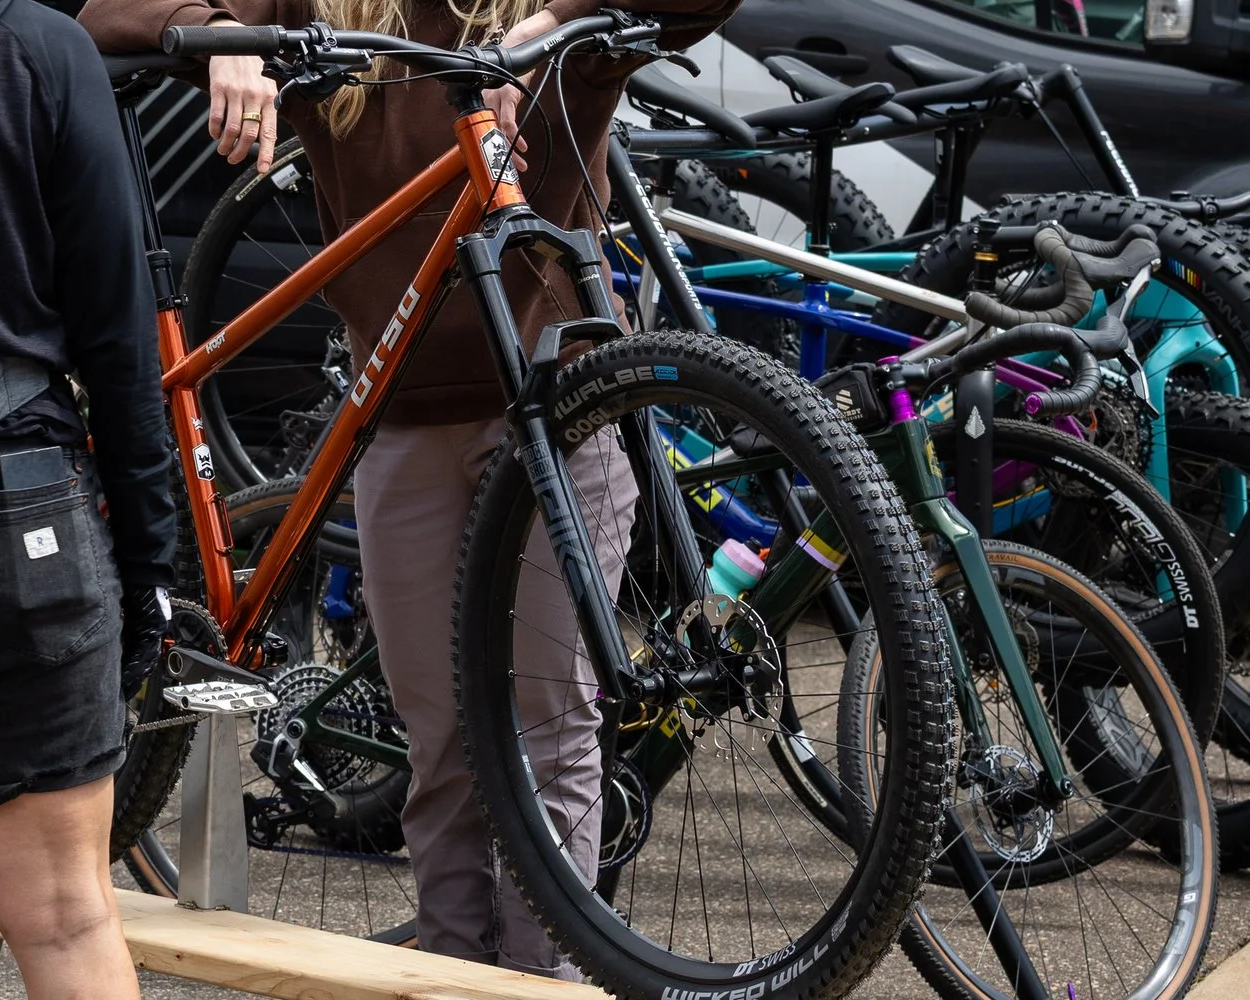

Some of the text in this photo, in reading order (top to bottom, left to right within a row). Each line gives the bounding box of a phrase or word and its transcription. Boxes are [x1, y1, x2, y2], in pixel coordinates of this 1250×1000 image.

[350, 283, 421, 408] OTSO
[554, 366, 655, 421] WALBE
[1167, 561, 1193, 602] SWISS
[1183, 605, 1200, 629] DT
[732, 943, 797, 977] DT SWISS
[771, 943, 829, 991] WILL
